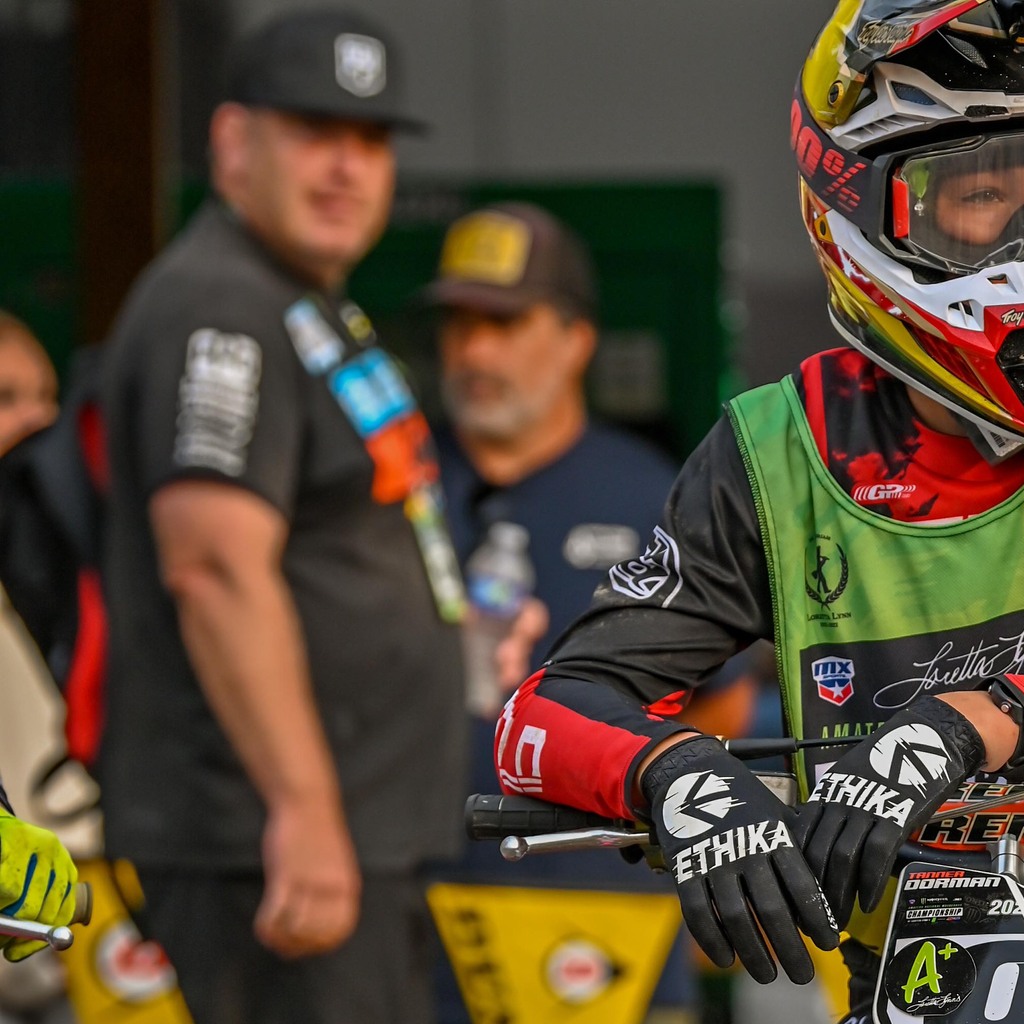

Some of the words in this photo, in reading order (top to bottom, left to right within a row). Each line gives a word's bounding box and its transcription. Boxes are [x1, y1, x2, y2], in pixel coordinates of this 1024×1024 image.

[1002, 309, 1024, 326] Troy
[807, 772, 915, 828] ETHIKA
[672, 820, 794, 884] ETHIKA
[907, 908, 962, 919] CHAMPIONSHIP
